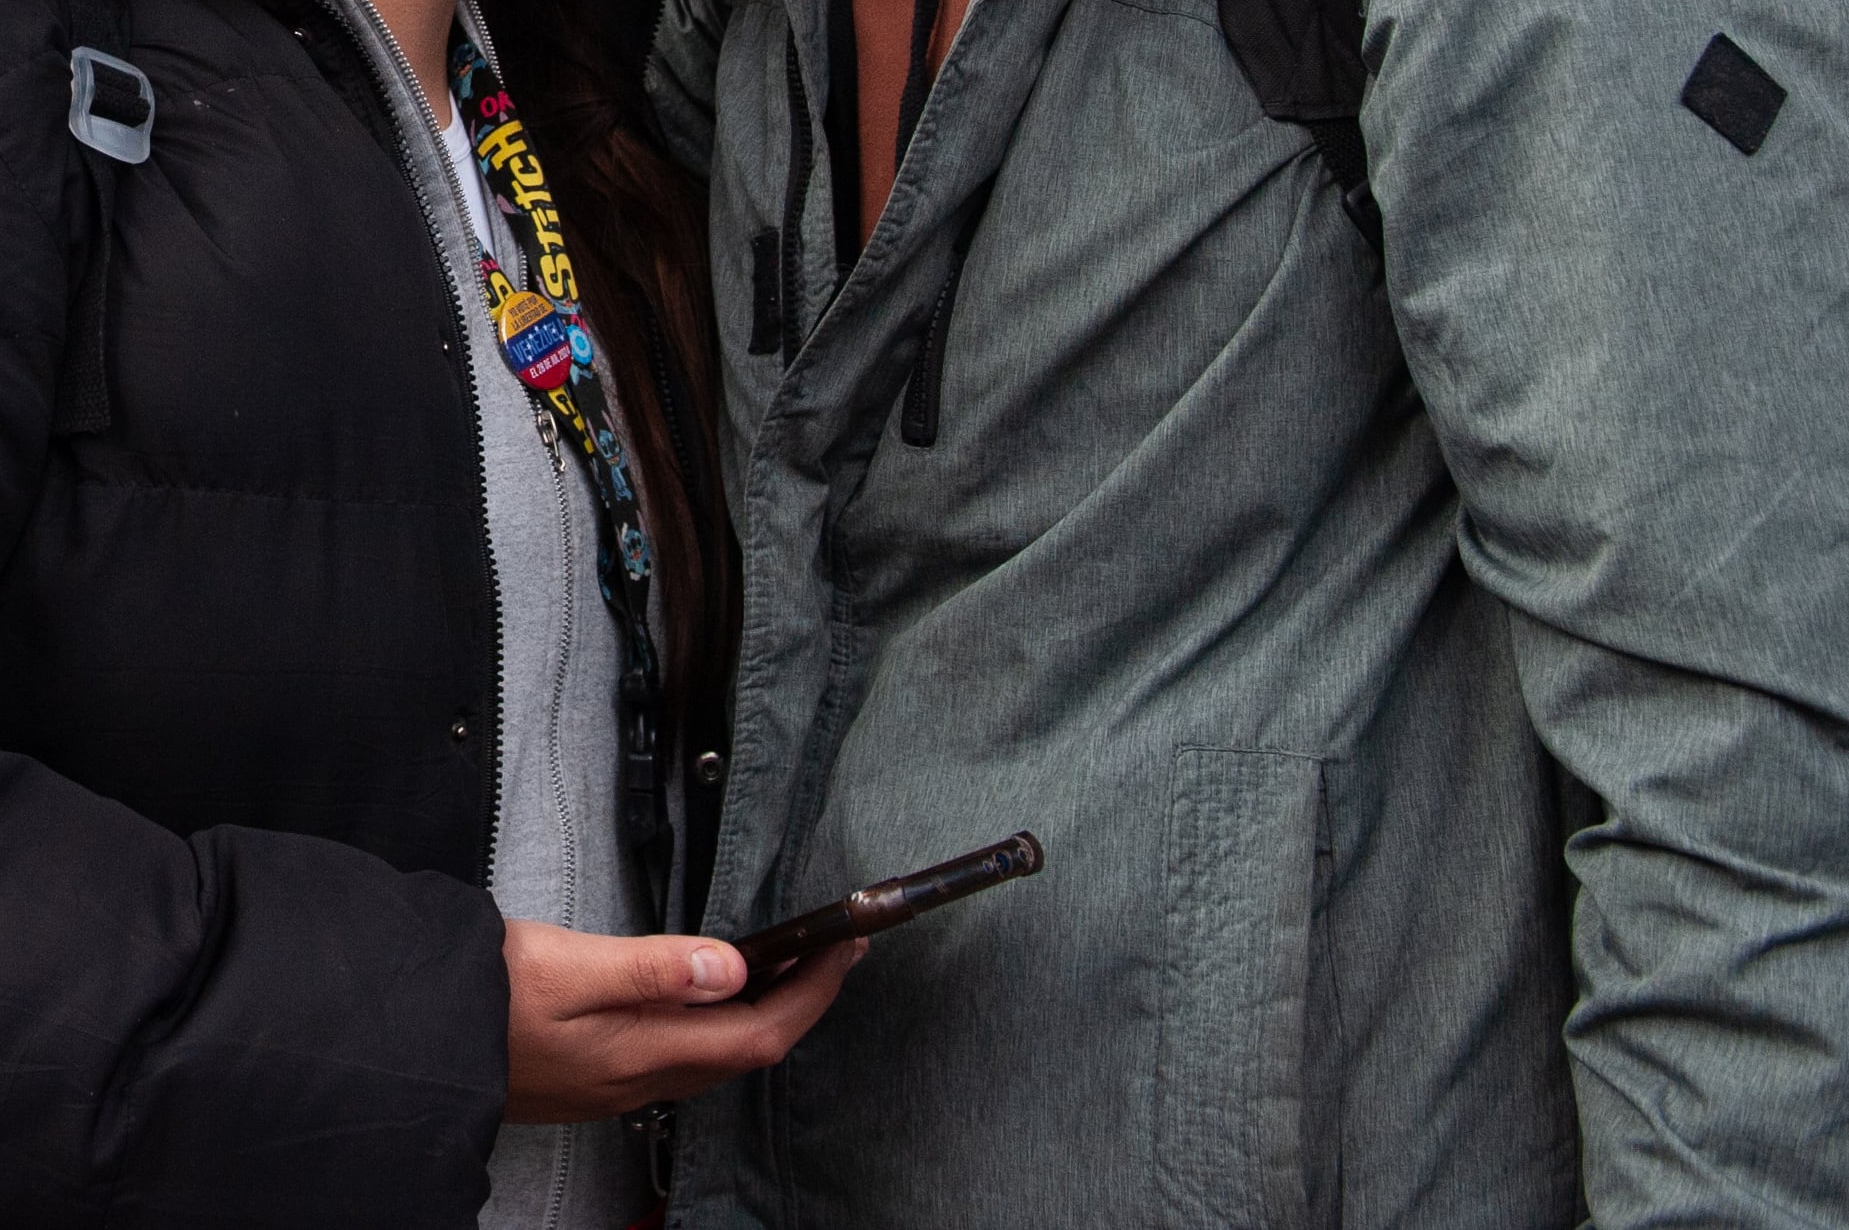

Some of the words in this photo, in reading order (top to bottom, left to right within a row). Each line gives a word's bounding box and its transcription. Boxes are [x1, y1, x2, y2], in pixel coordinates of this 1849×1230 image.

[519, 307, 541, 326] LIBERTAD
[529, 367, 539, 379] EL
[536, 363, 546, 374] 28
[543, 359, 553, 370] DE
[550, 353, 560, 365] JUL
